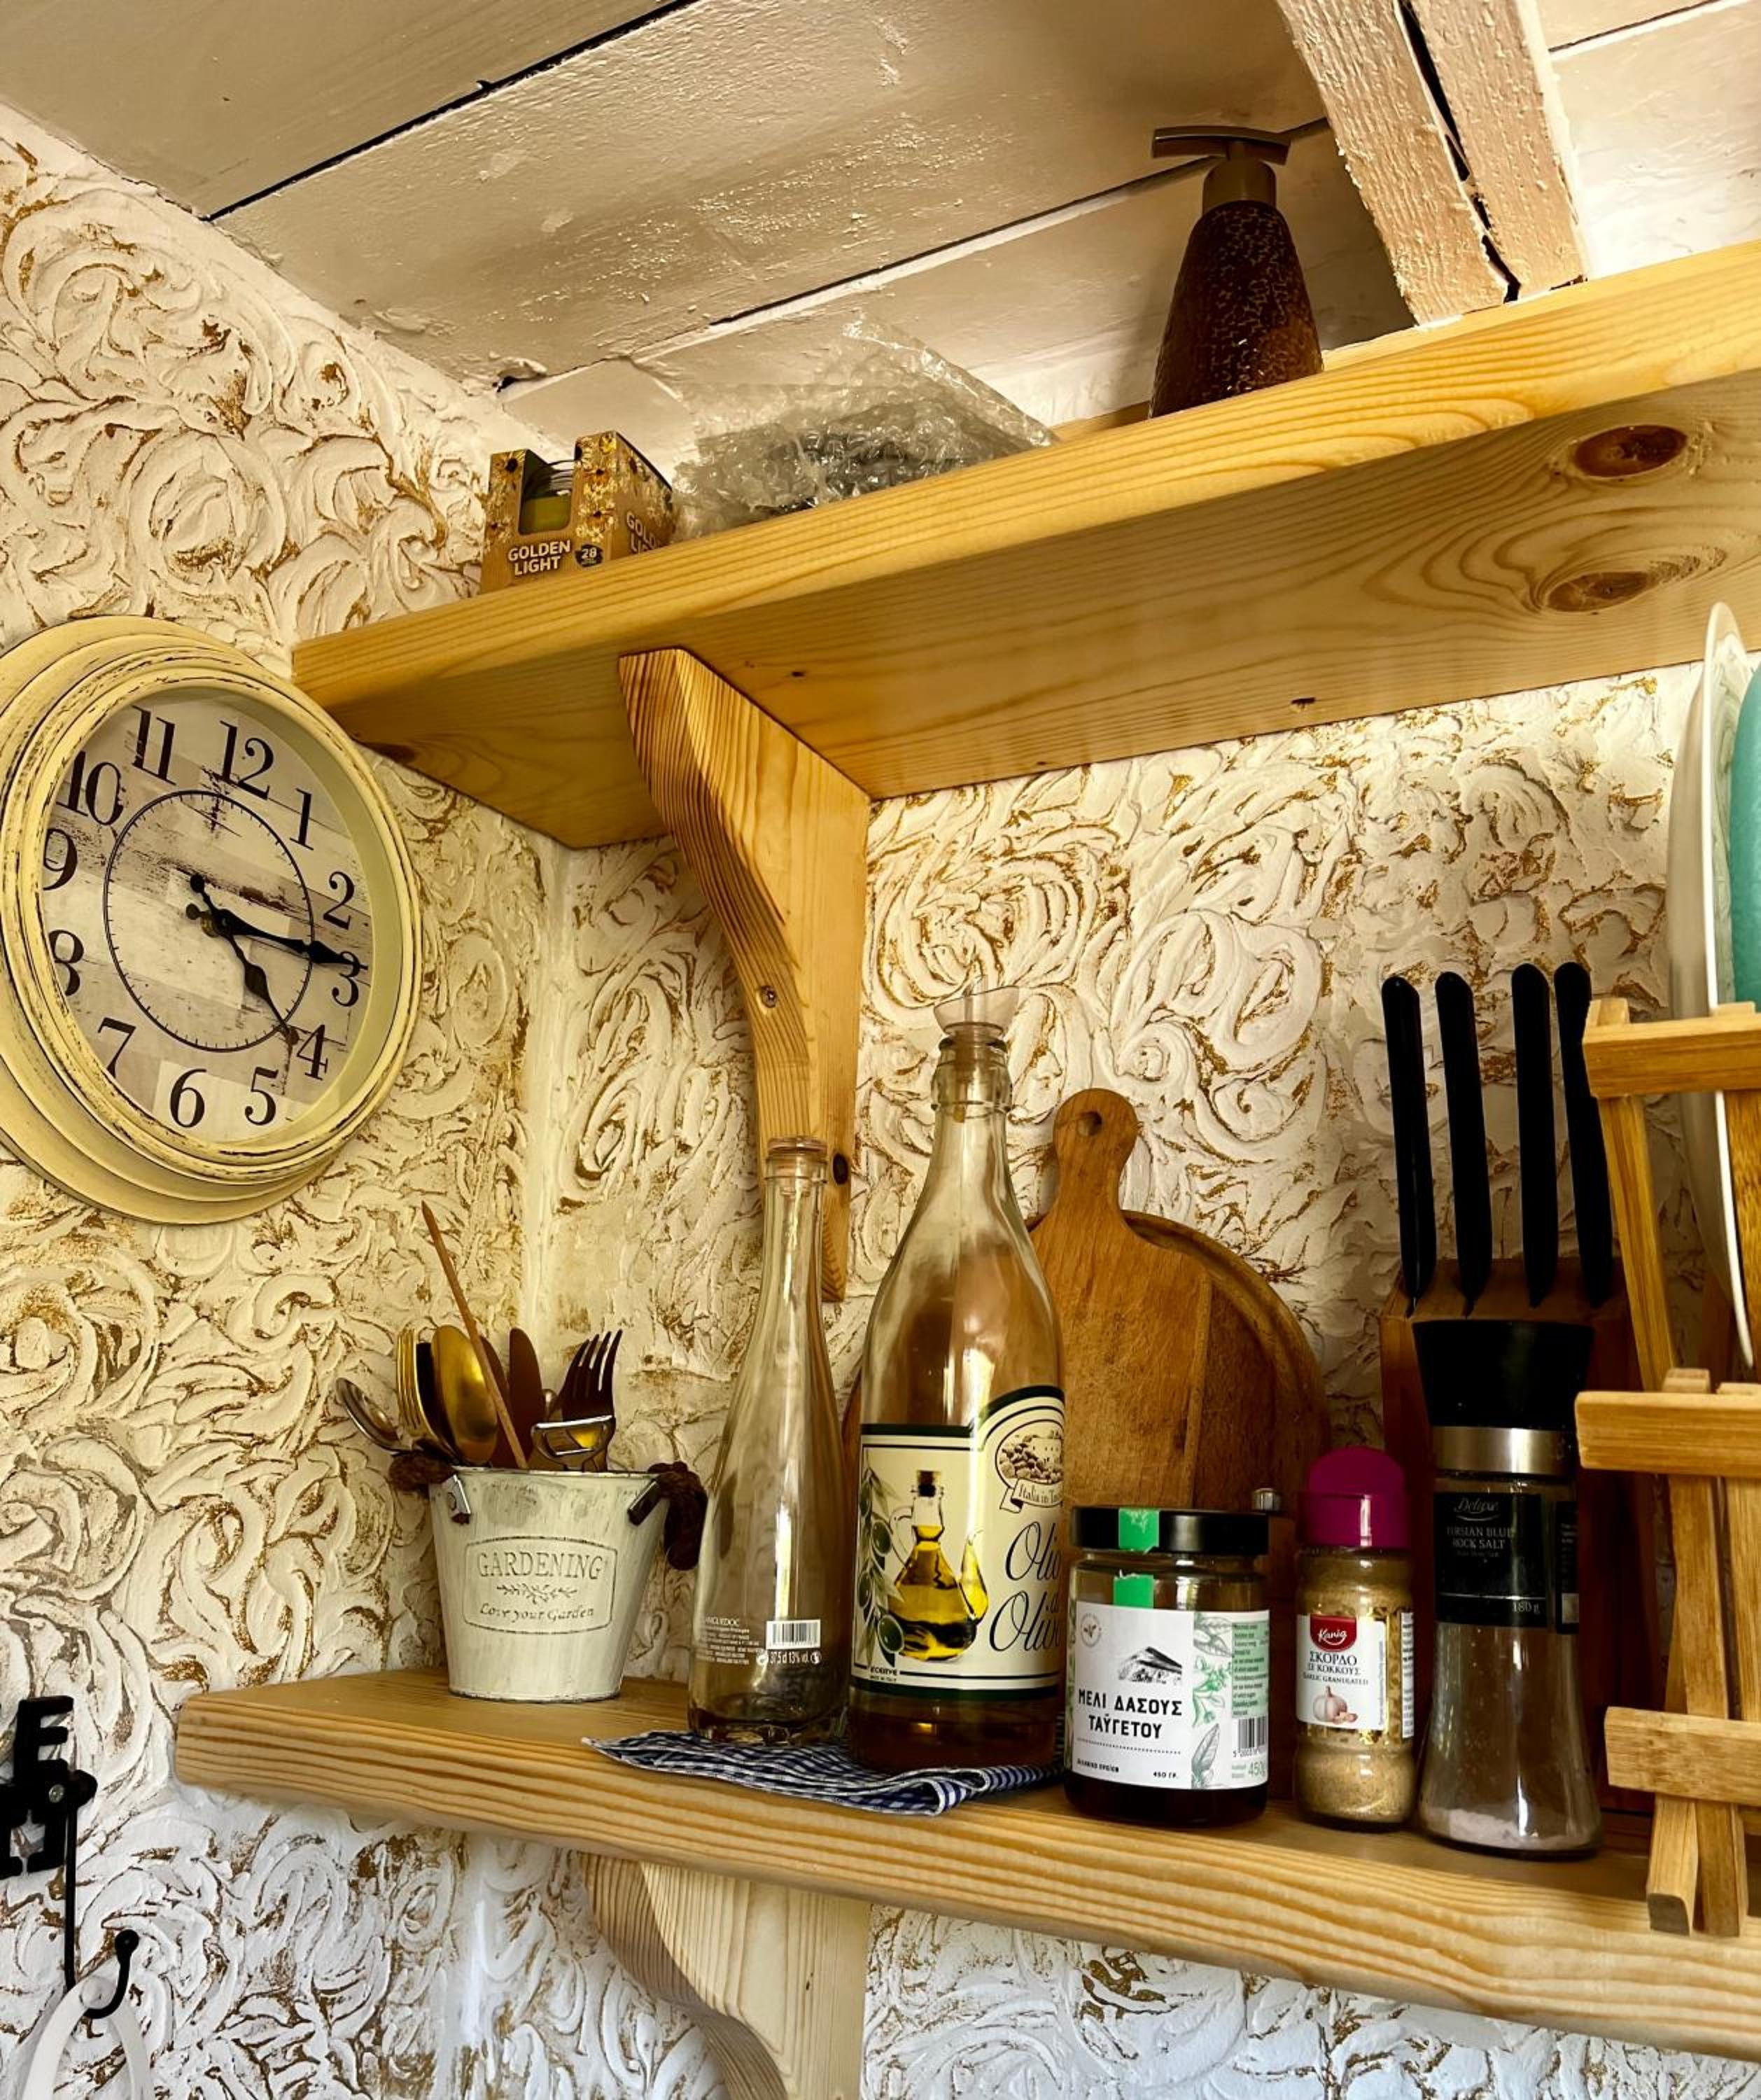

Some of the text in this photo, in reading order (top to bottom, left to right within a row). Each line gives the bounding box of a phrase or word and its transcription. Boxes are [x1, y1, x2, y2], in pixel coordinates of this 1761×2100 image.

[508, 540, 570, 561] GOLDEN
[514, 556, 560, 575] LIGHT
[581, 547, 596, 559] 28
[132, 705, 176, 785] 11
[220, 720, 274, 801] 12
[55, 750, 124, 825] 10
[289, 788, 314, 850] 1
[43, 828, 78, 890] 9
[323, 871, 355, 930] 2
[331, 951, 361, 1007] 3
[97, 1017, 136, 1078] 7
[296, 1024, 329, 1082] 4
[169, 1068, 208, 1128] 6
[244, 1066, 279, 1126] 5
[477, 1551, 603, 1580] GARDENING
[1479, 1539, 1505, 1549] SALT
[547, 1604, 594, 1621] Garden
[1513, 1602, 1533, 1612] 180
[1310, 1651, 1358, 1666] ΣΚΟΡΔΟ
[1318, 1628, 1348, 1643] Kania
[1078, 1689, 1182, 1716] ΜΕΛΙ ΔΑΣΟΥΣ
